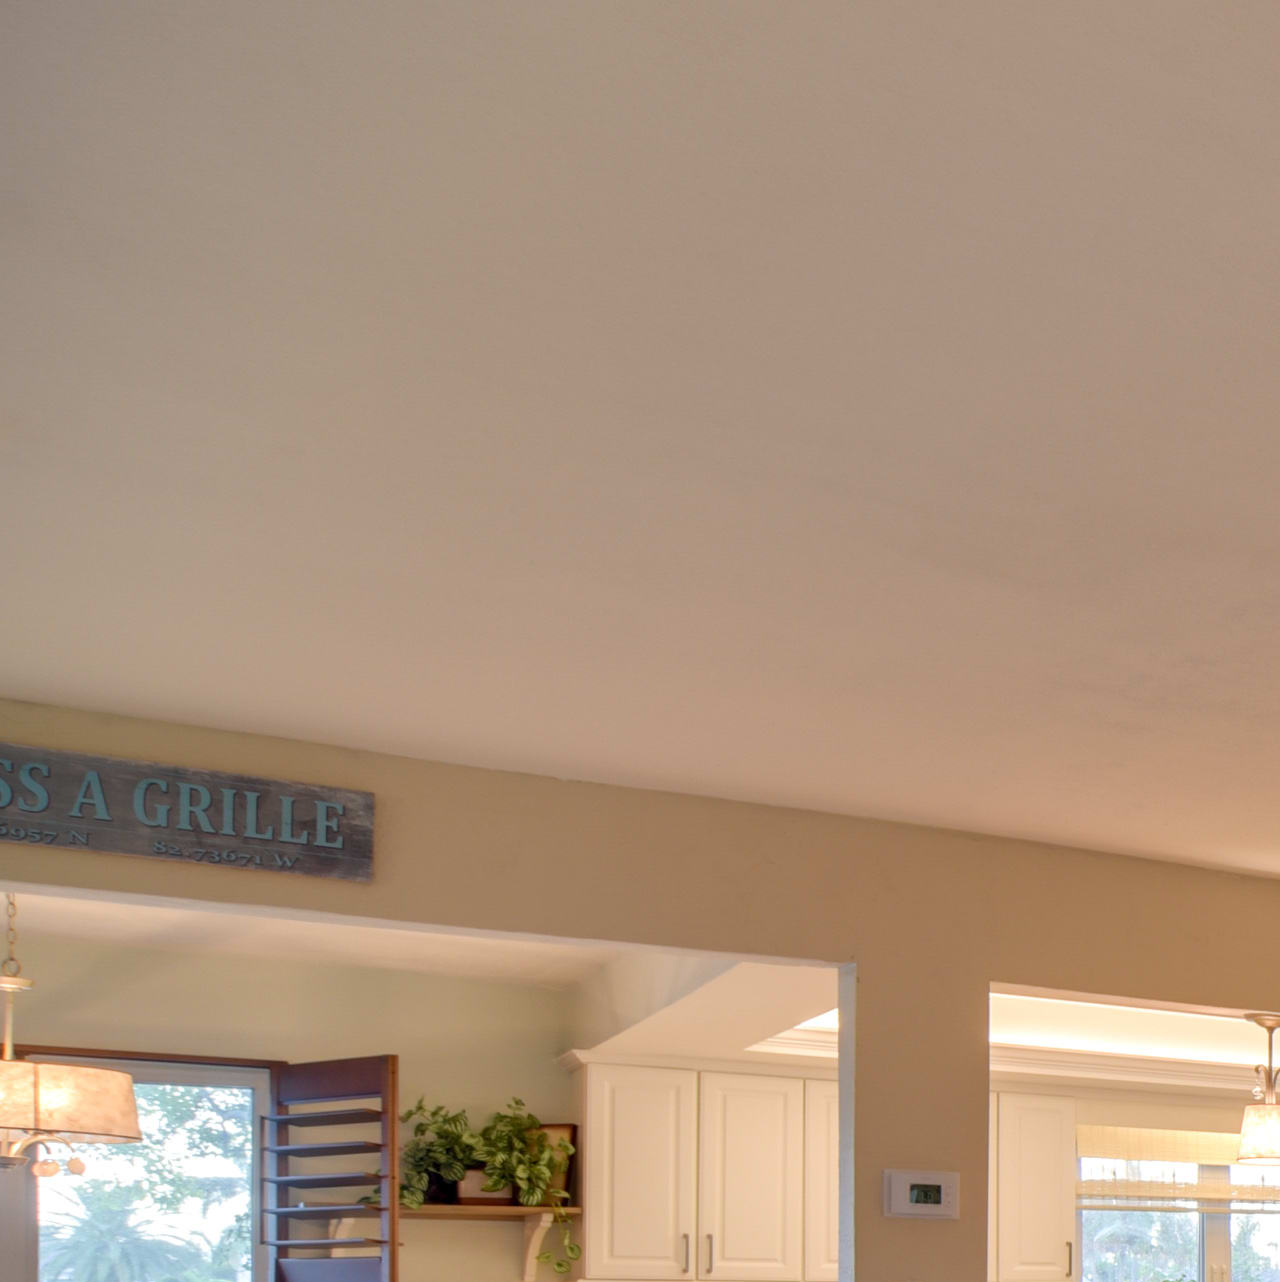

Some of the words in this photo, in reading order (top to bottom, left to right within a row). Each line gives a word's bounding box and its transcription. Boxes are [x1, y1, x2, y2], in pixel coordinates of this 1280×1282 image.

[68, 770, 113, 821] A
[133, 777, 345, 849] GRILLE
[69, 830, 89, 845] N
[152, 840, 264, 867] 82.73671
[272, 853, 298, 869] W
